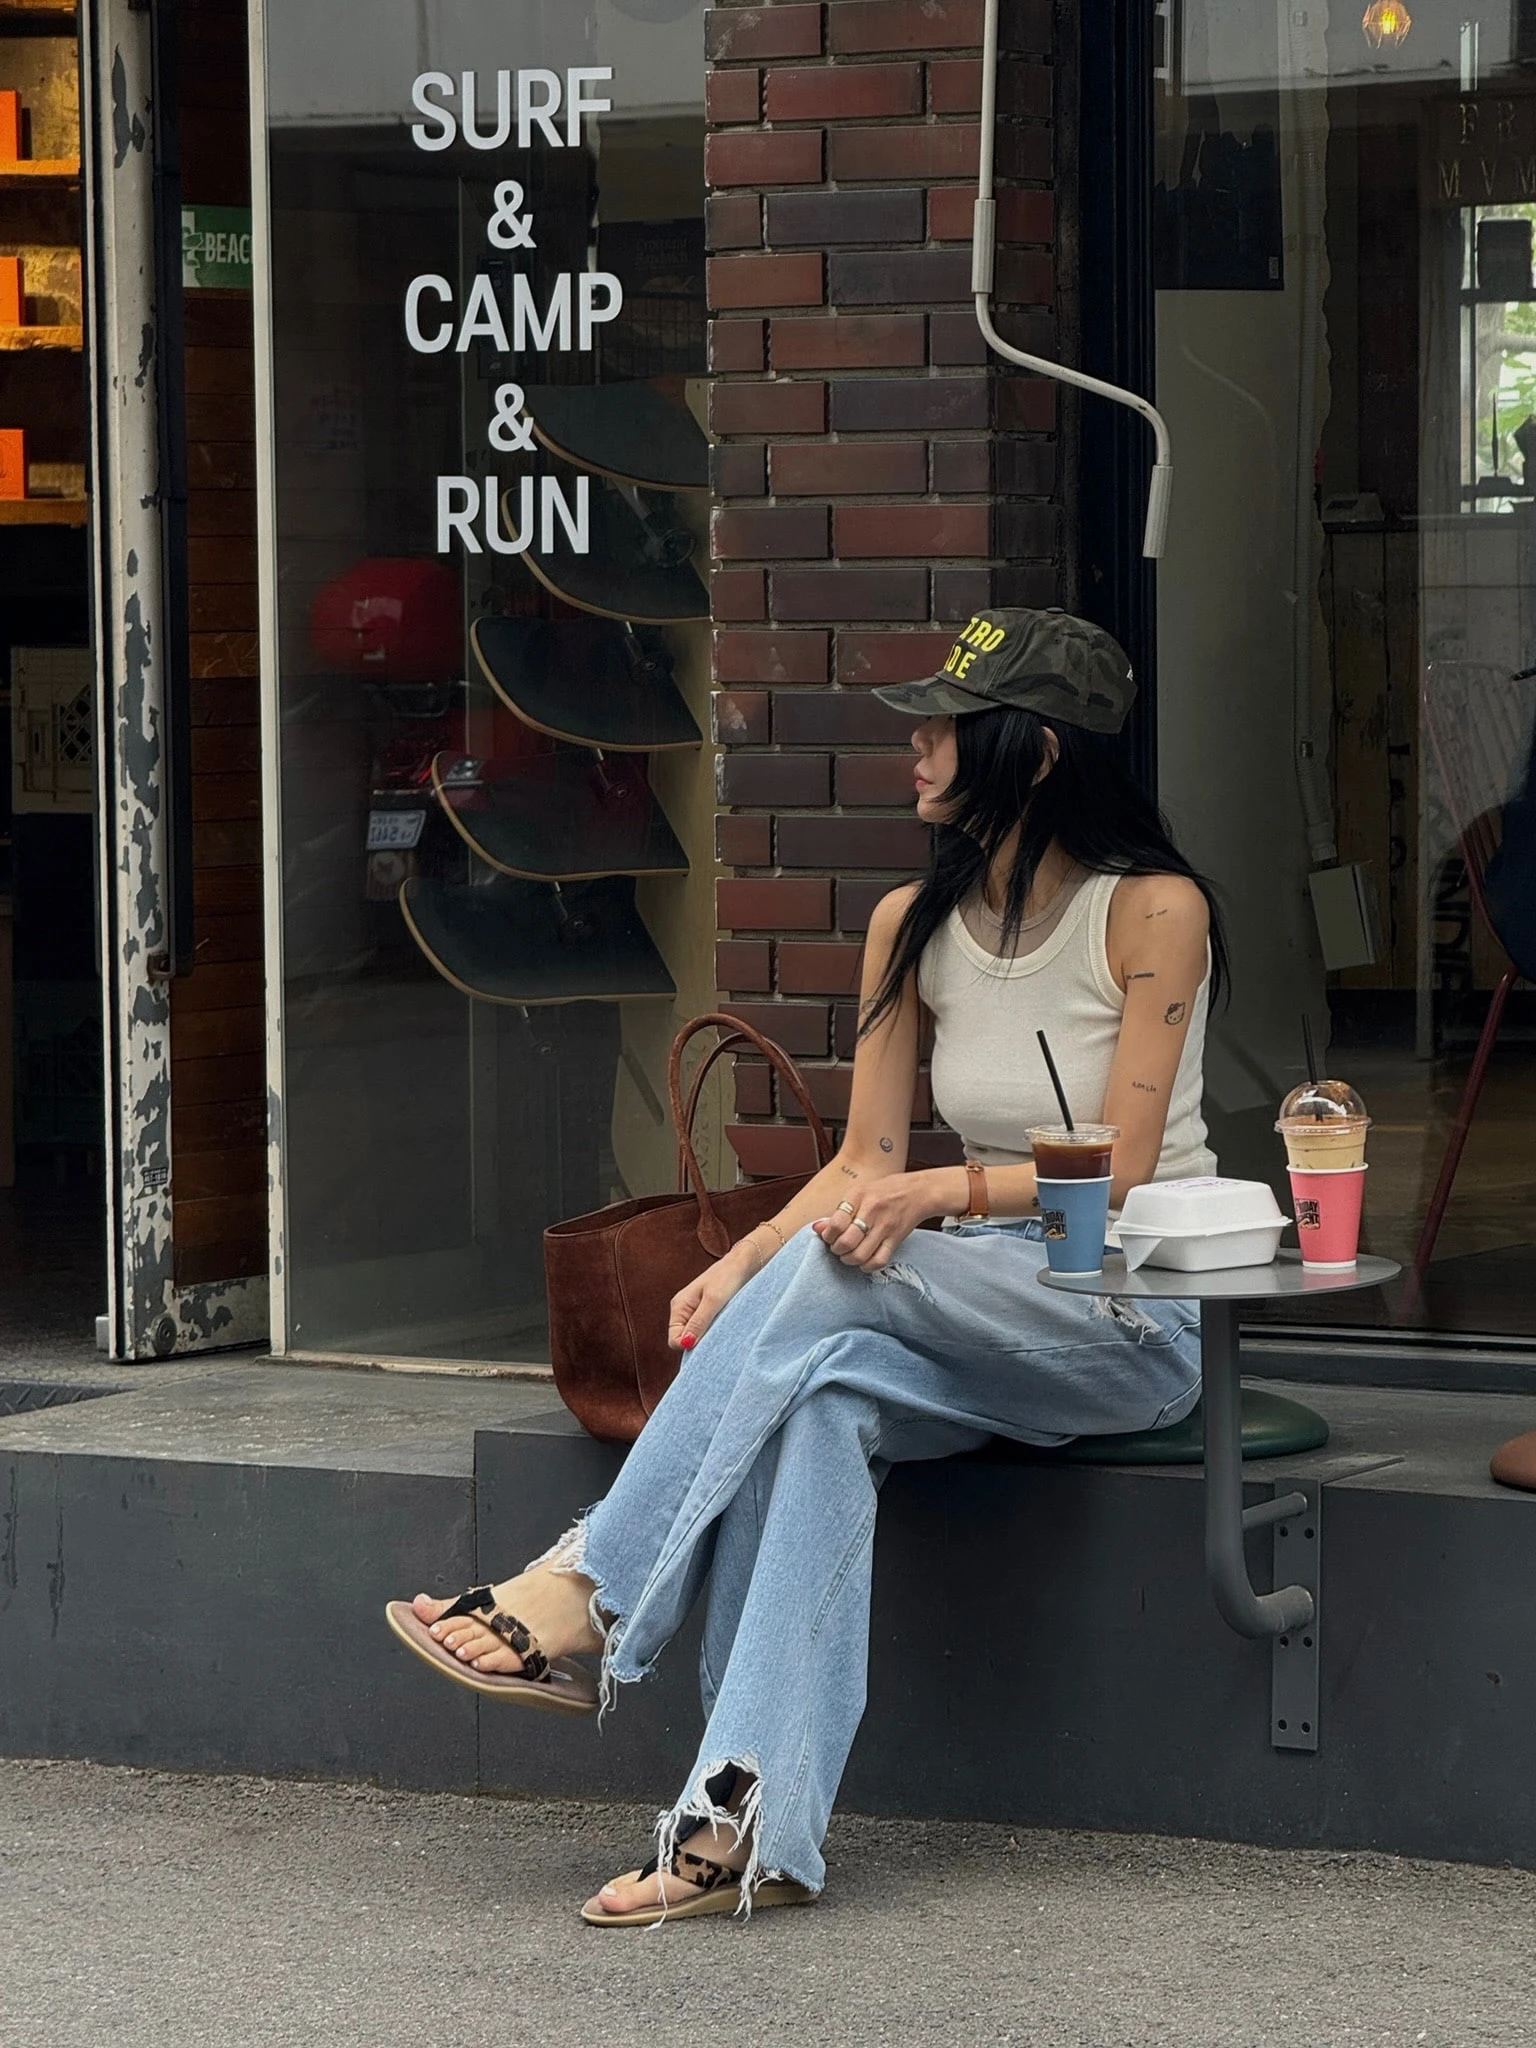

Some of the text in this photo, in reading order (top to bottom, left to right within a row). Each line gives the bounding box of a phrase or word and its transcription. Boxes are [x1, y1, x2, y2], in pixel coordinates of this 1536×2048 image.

[411, 66, 613, 151] SURF
[204, 231, 253, 265] BEAC
[487, 180, 537, 250] &
[404, 271, 623, 354] CAMP
[487, 383, 537, 453] &
[436, 475, 590, 555] RUN
[944, 643, 978, 679] DE
